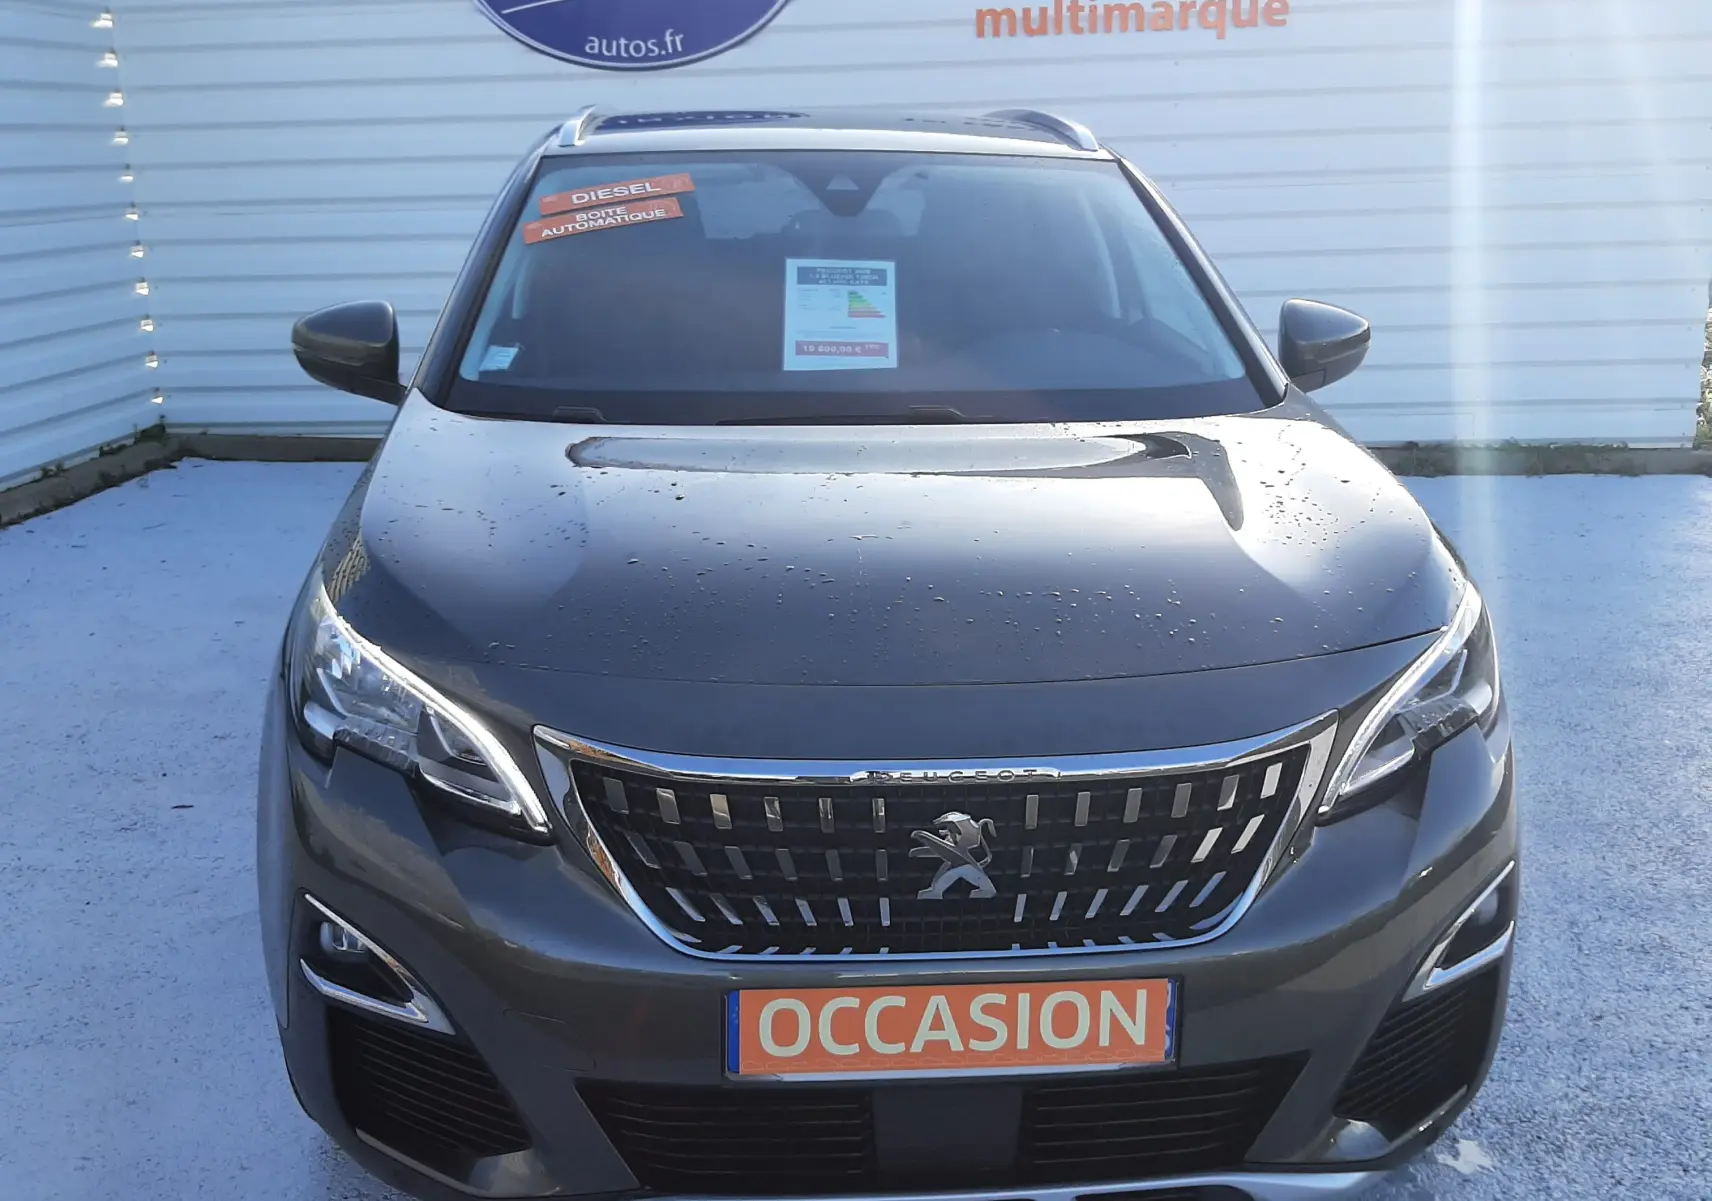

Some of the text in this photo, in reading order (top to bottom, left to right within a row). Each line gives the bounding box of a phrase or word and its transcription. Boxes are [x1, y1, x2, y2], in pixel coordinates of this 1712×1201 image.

[975, 0, 1290, 39] multimarque
[584, 28, 684, 57] autos.fr
[571, 182, 661, 204] DIESEL
[541, 208, 666, 237] AUTOMATIQUE
[575, 206, 628, 222] BOITE
[872, 769, 1037, 784] PEUGEOT
[758, 988, 1148, 1057] OCCASION
